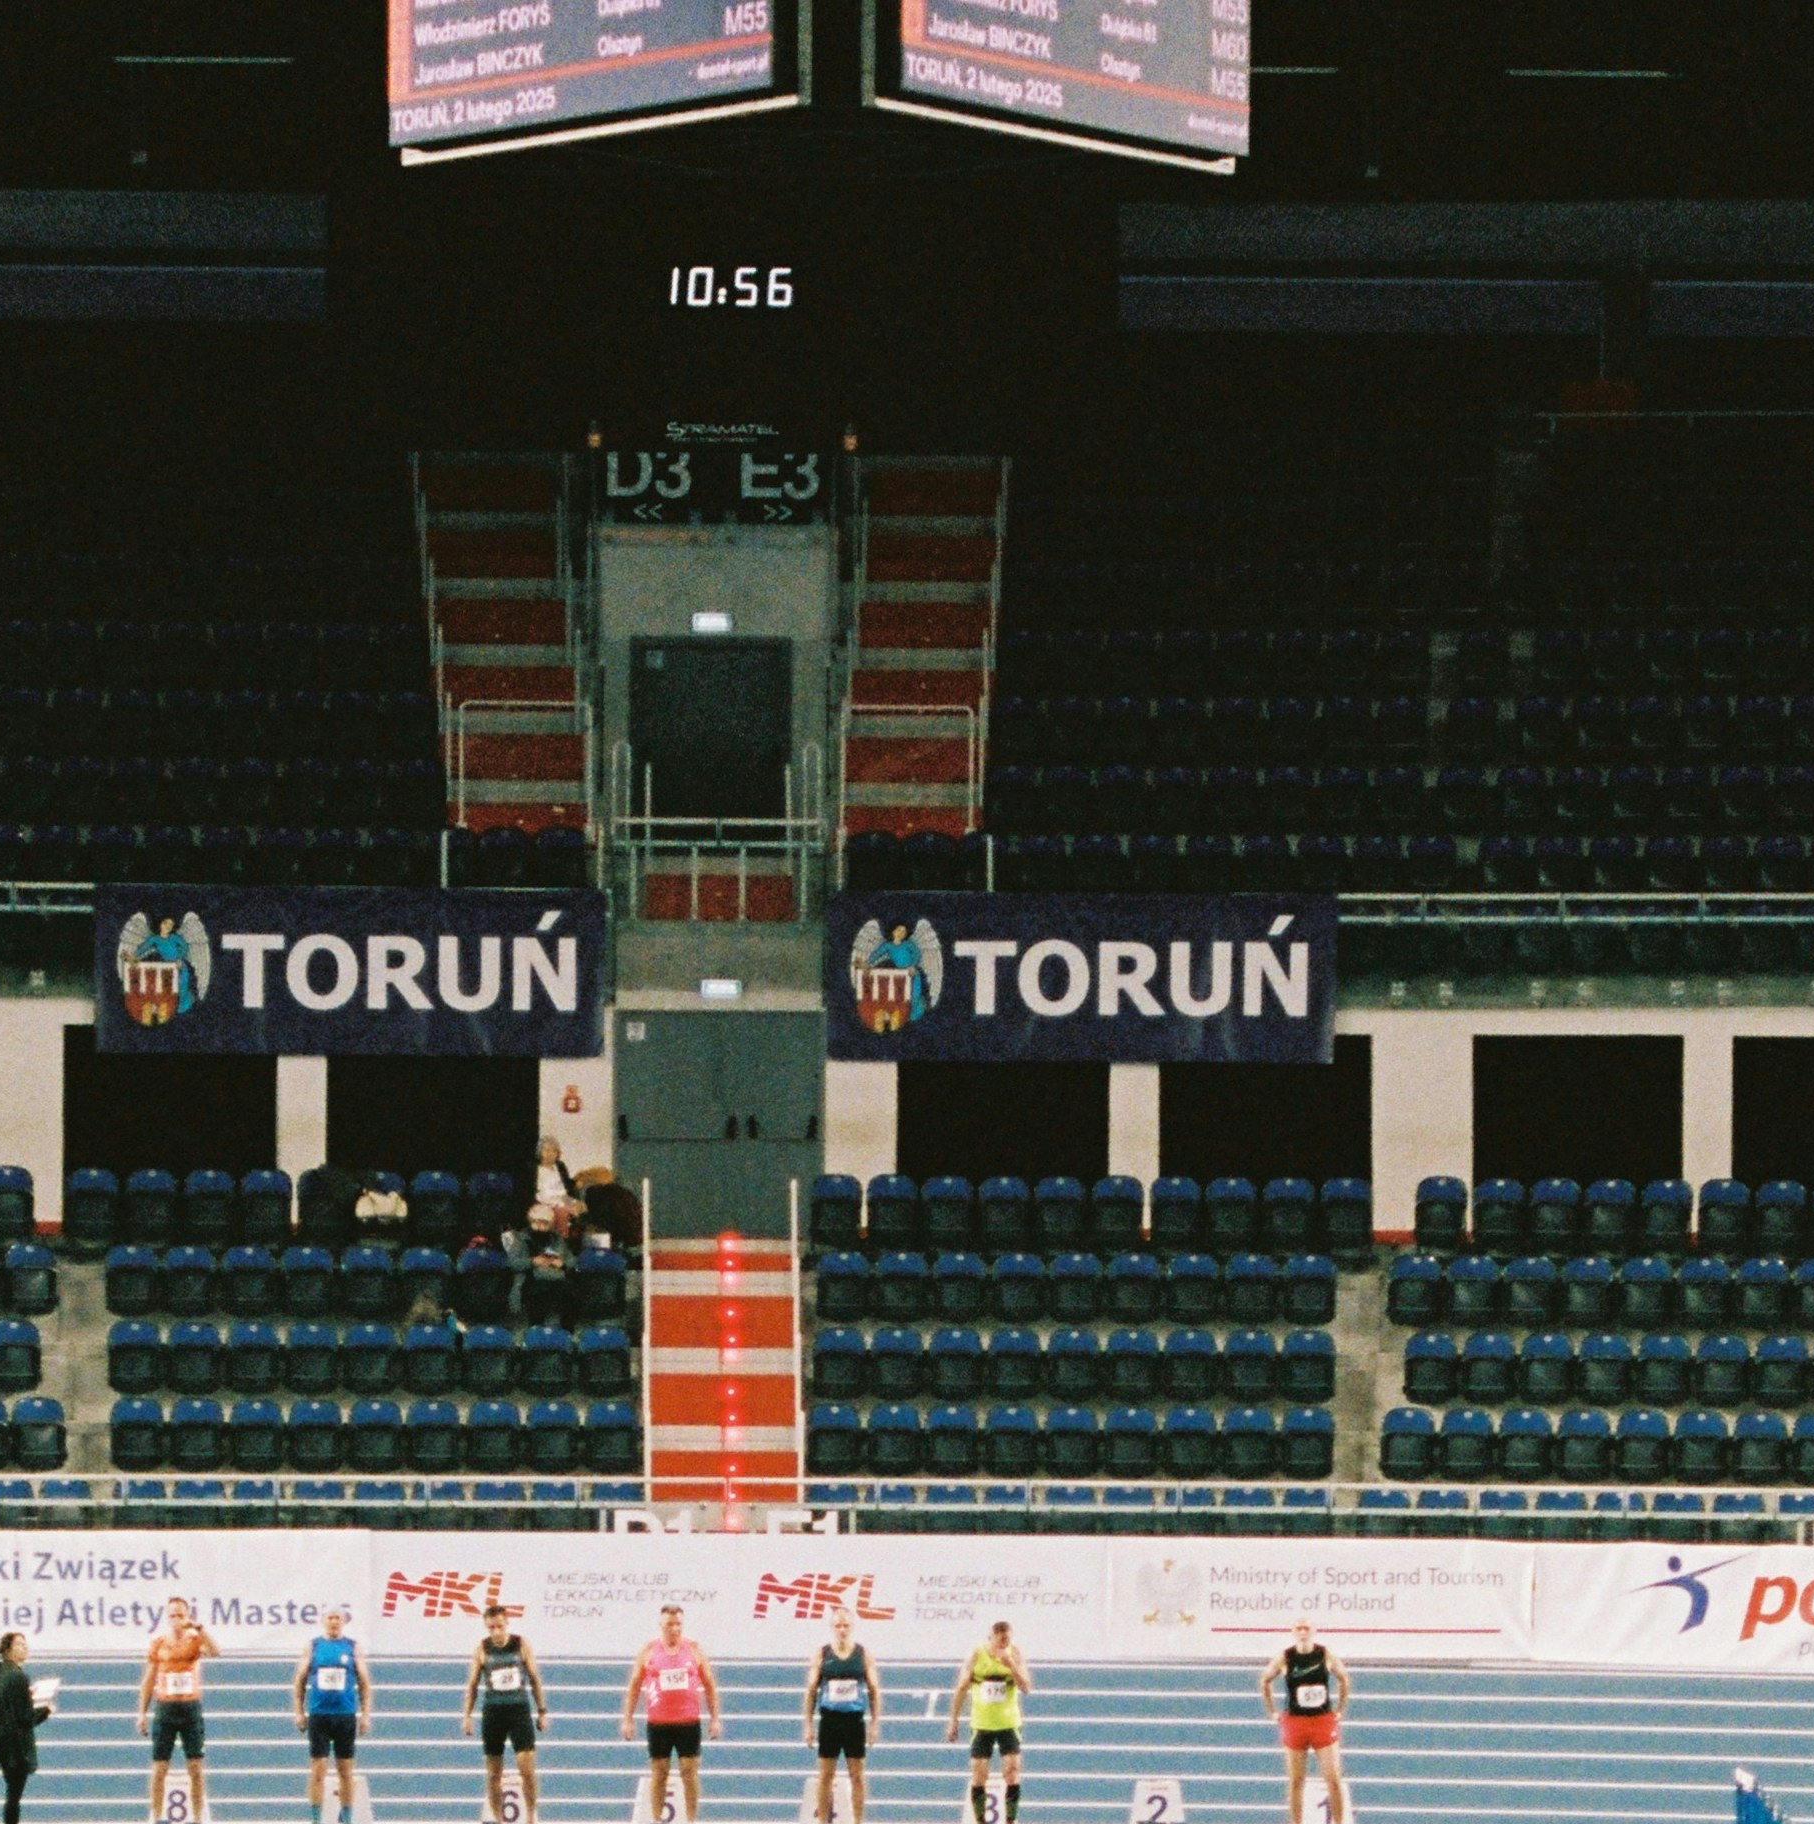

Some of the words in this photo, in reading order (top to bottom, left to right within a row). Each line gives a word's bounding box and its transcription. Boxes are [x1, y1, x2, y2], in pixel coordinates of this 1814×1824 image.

[724, 1, 768, 35] M55
[454, 101, 465, 123] 2
[467, 99, 514, 125] lutego
[516, 85, 556, 114] 2025
[966, 66, 977, 90] 2
[1025, 79, 1064, 109] 2025
[670, 266, 794, 307] 10:56
[606, 452, 693, 499] D3
[740, 452, 821, 500] E3
[221, 911, 579, 1013] TORUŃ
[954, 914, 1310, 1018] TORUŃ
[33, 1550, 181, 1588] Związek
[546, 1572, 617, 1587] MIEJSKI
[620, 1572, 671, 1587] KLUB
[916, 1574, 988, 1589] MIEJSKI
[991, 1575, 1042, 1589] KLUB
[1210, 1566, 1292, 1589] Ministry
[1298, 1566, 1319, 1585] of
[1324, 1567, 1378, 1589] Sport
[1385, 1567, 1421, 1586] and
[1427, 1567, 1504, 1587] Tourism
[382, 1571, 526, 1619] MKL
[543, 1588, 719, 1603] LEKKOATLETYCZNY
[753, 1572, 897, 1620] MKL
[914, 1591, 1090, 1607] LEKKOATLETYCZNY
[1210, 1591, 1294, 1612] Republic
[1301, 1592, 1322, 1611] of
[1327, 1592, 1395, 1612] Poland
[56, 1597, 198, 1635] Atletyi
[168, 1790, 186, 1822] 8
[501, 1790, 520, 1823] 6
